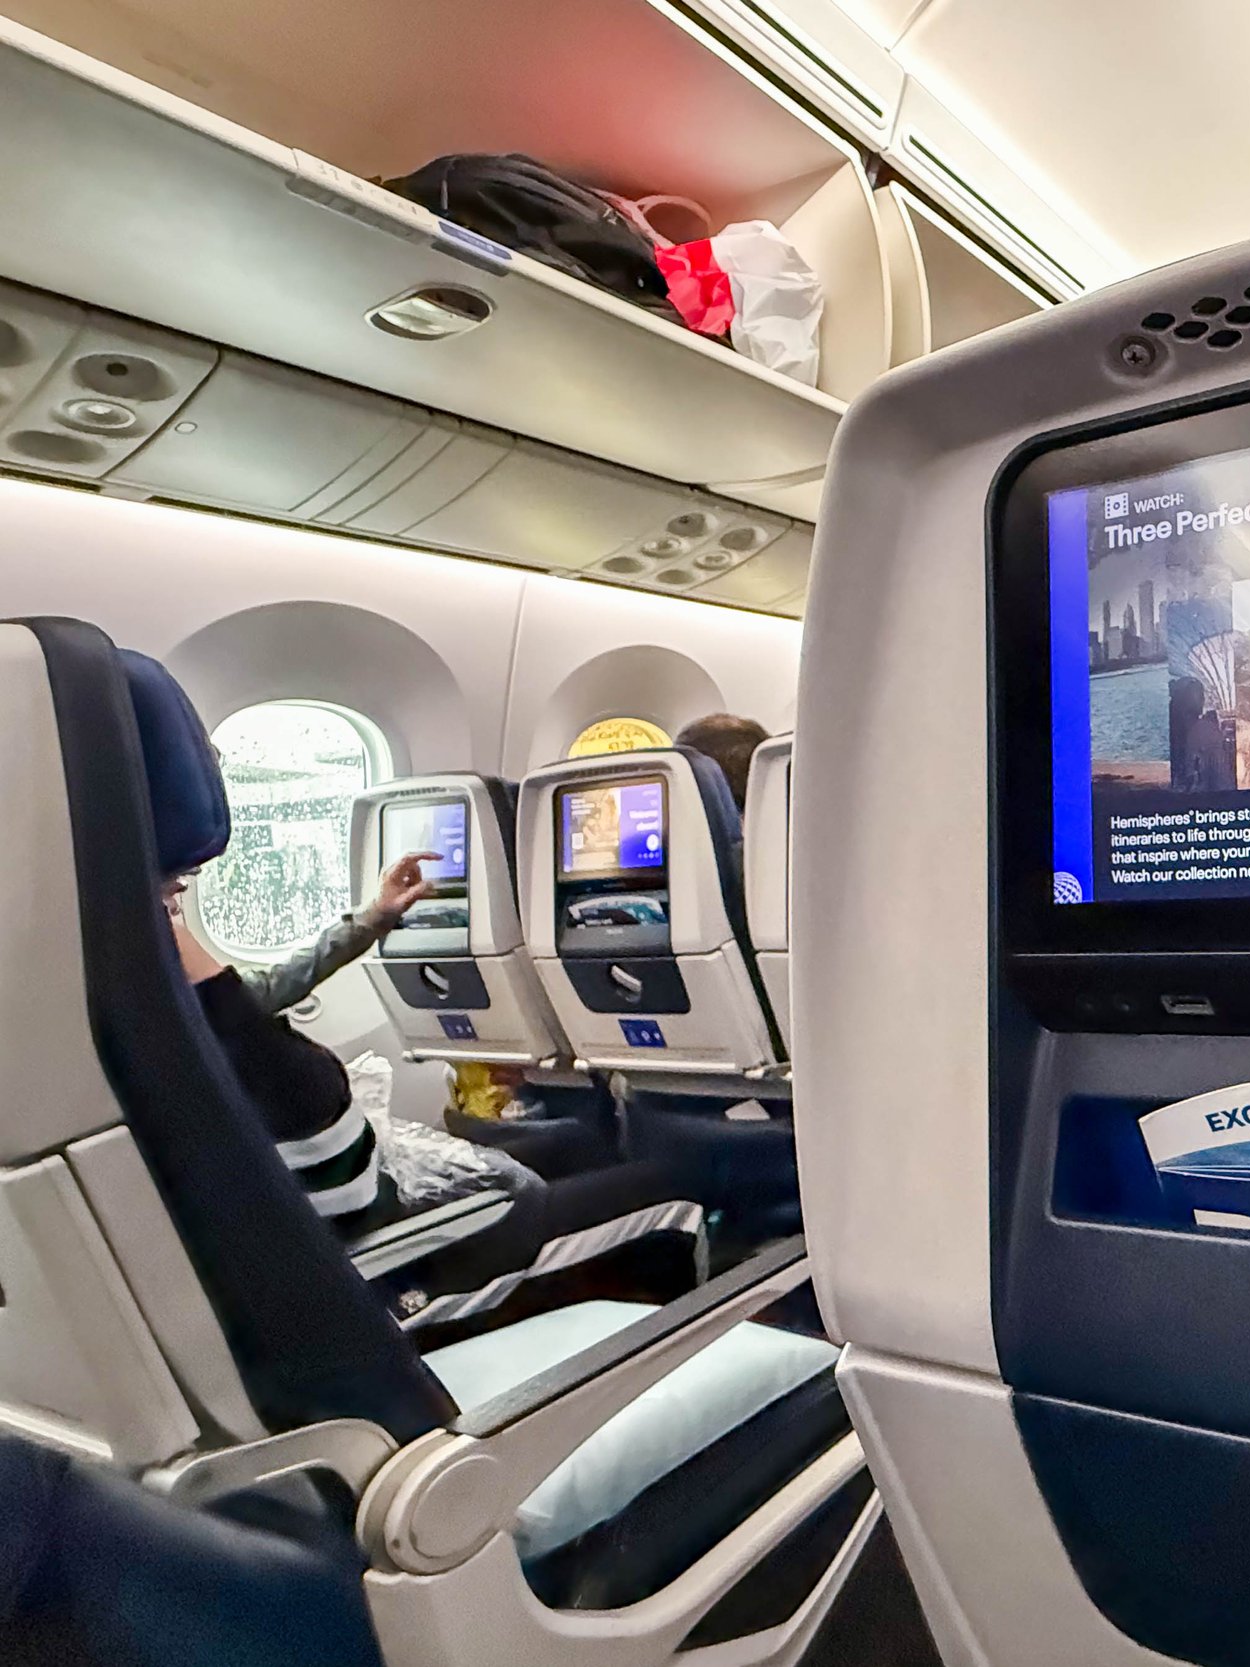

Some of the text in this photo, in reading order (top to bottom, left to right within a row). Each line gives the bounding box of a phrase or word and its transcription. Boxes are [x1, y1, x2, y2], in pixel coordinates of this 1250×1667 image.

[1133, 493, 1185, 514] WATCH:
[1104, 520, 1173, 549] Three
[1195, 809, 1236, 826] brings
[1111, 831, 1171, 847] itineraries
[1171, 829, 1186, 843] to
[1187, 828, 1207, 842] life
[1111, 850, 1137, 865] that
[1138, 849, 1179, 866] inspire
[1179, 846, 1221, 862] where
[1111, 868, 1151, 884] Watch
[1151, 870, 1174, 882] our
[1174, 865, 1237, 880] collection
